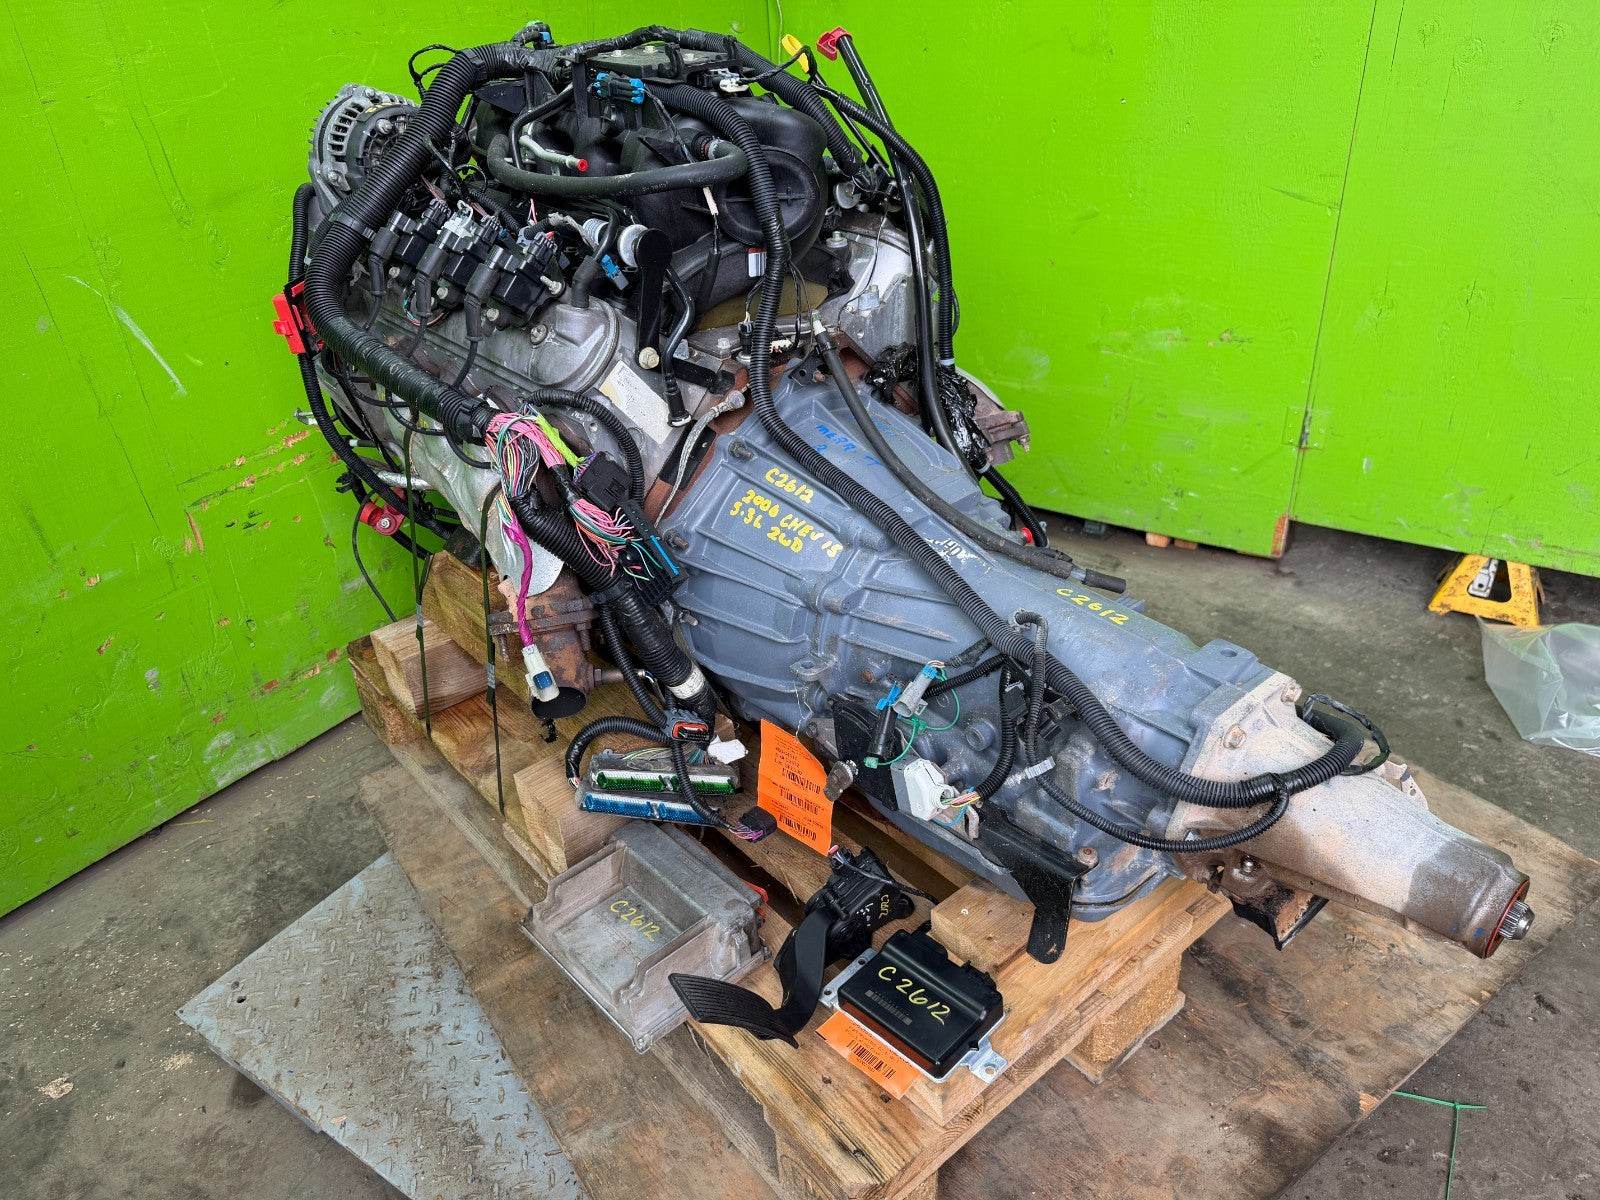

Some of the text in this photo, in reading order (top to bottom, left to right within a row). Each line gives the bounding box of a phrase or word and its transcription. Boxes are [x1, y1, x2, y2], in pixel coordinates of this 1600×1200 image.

[765, 468, 814, 504] C2612
[729, 501, 763, 529] 5.3L
[741, 489, 844, 558] 2006 CHEV 15
[1056, 588, 1130, 626] C2612
[610, 900, 661, 942] C2612
